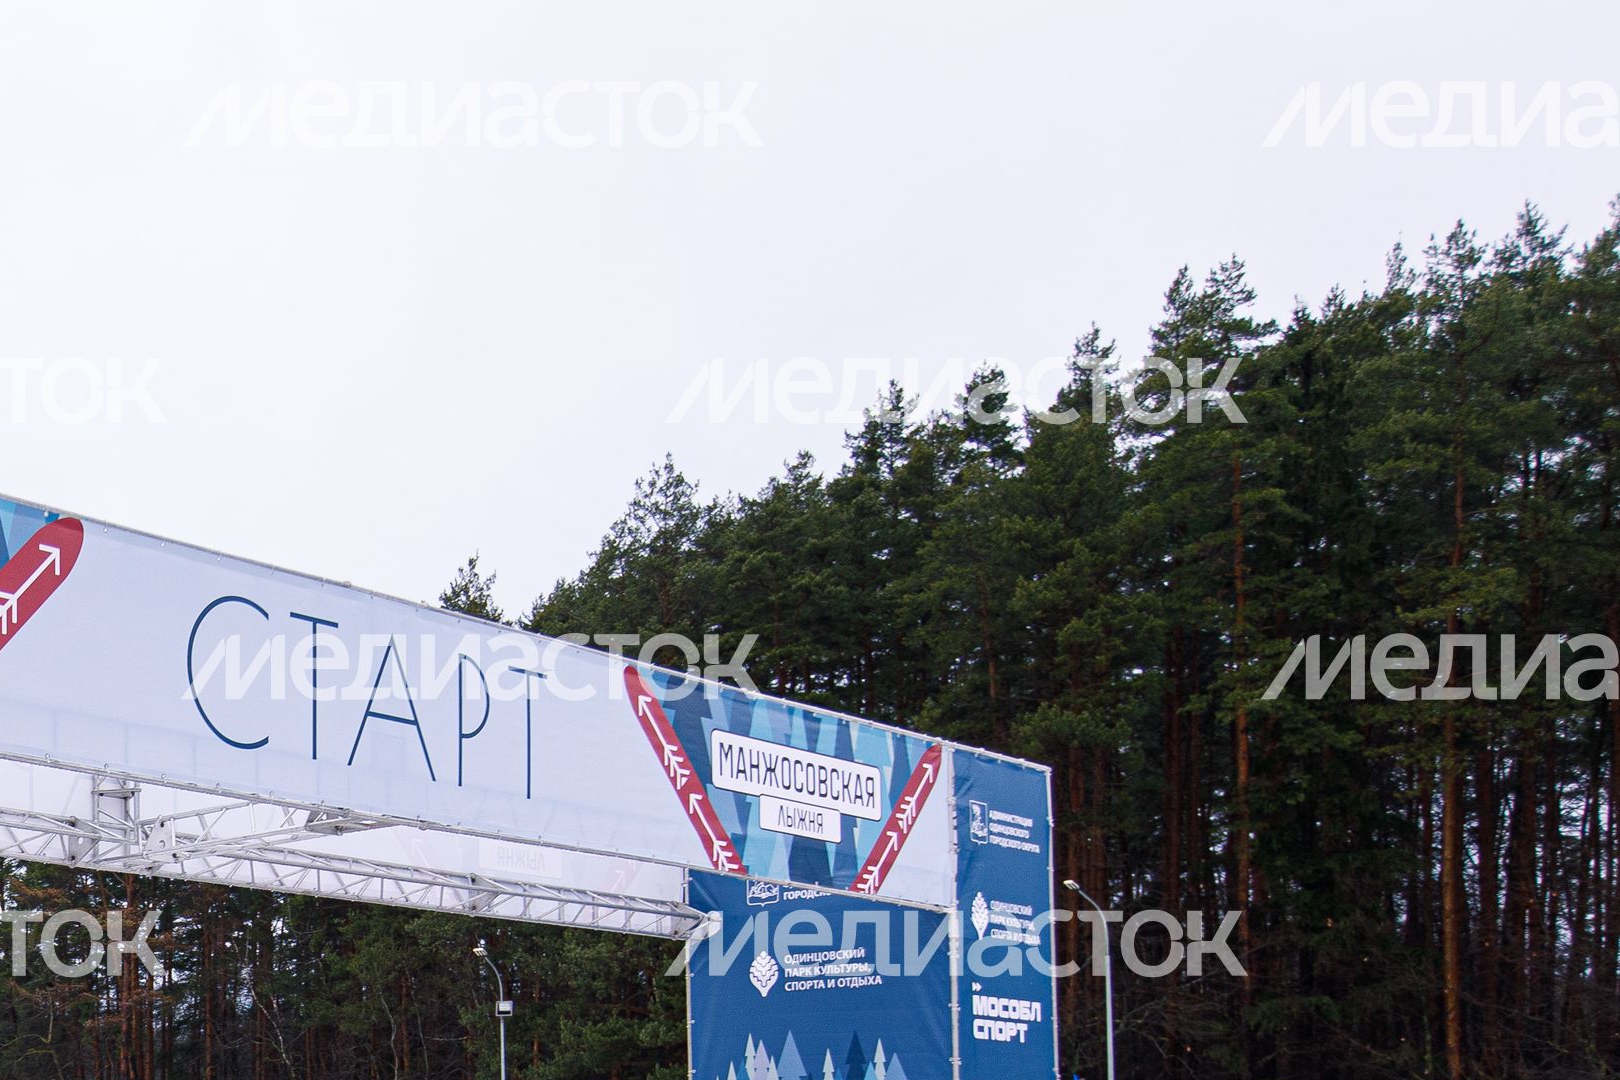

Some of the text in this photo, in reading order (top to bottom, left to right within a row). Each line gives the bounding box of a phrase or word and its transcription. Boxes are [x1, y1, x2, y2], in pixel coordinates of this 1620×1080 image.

[187, 595, 547, 799] СТАРТ
[717, 741, 877, 809] МАНЖОСОВСКАЯ
[776, 812, 824, 835] ЛЫЖНЯ
[784, 946, 865, 965] ОДИНЦОВСКИЙ
[784, 962, 872, 978] ПАРК КУЛЬТУРЫ,
[784, 975, 883, 992] СПОРТА И ОТДЫХА
[972, 994, 1042, 1022] МОСОБЛ
[972, 1018, 1028, 1043] СПОРТ
